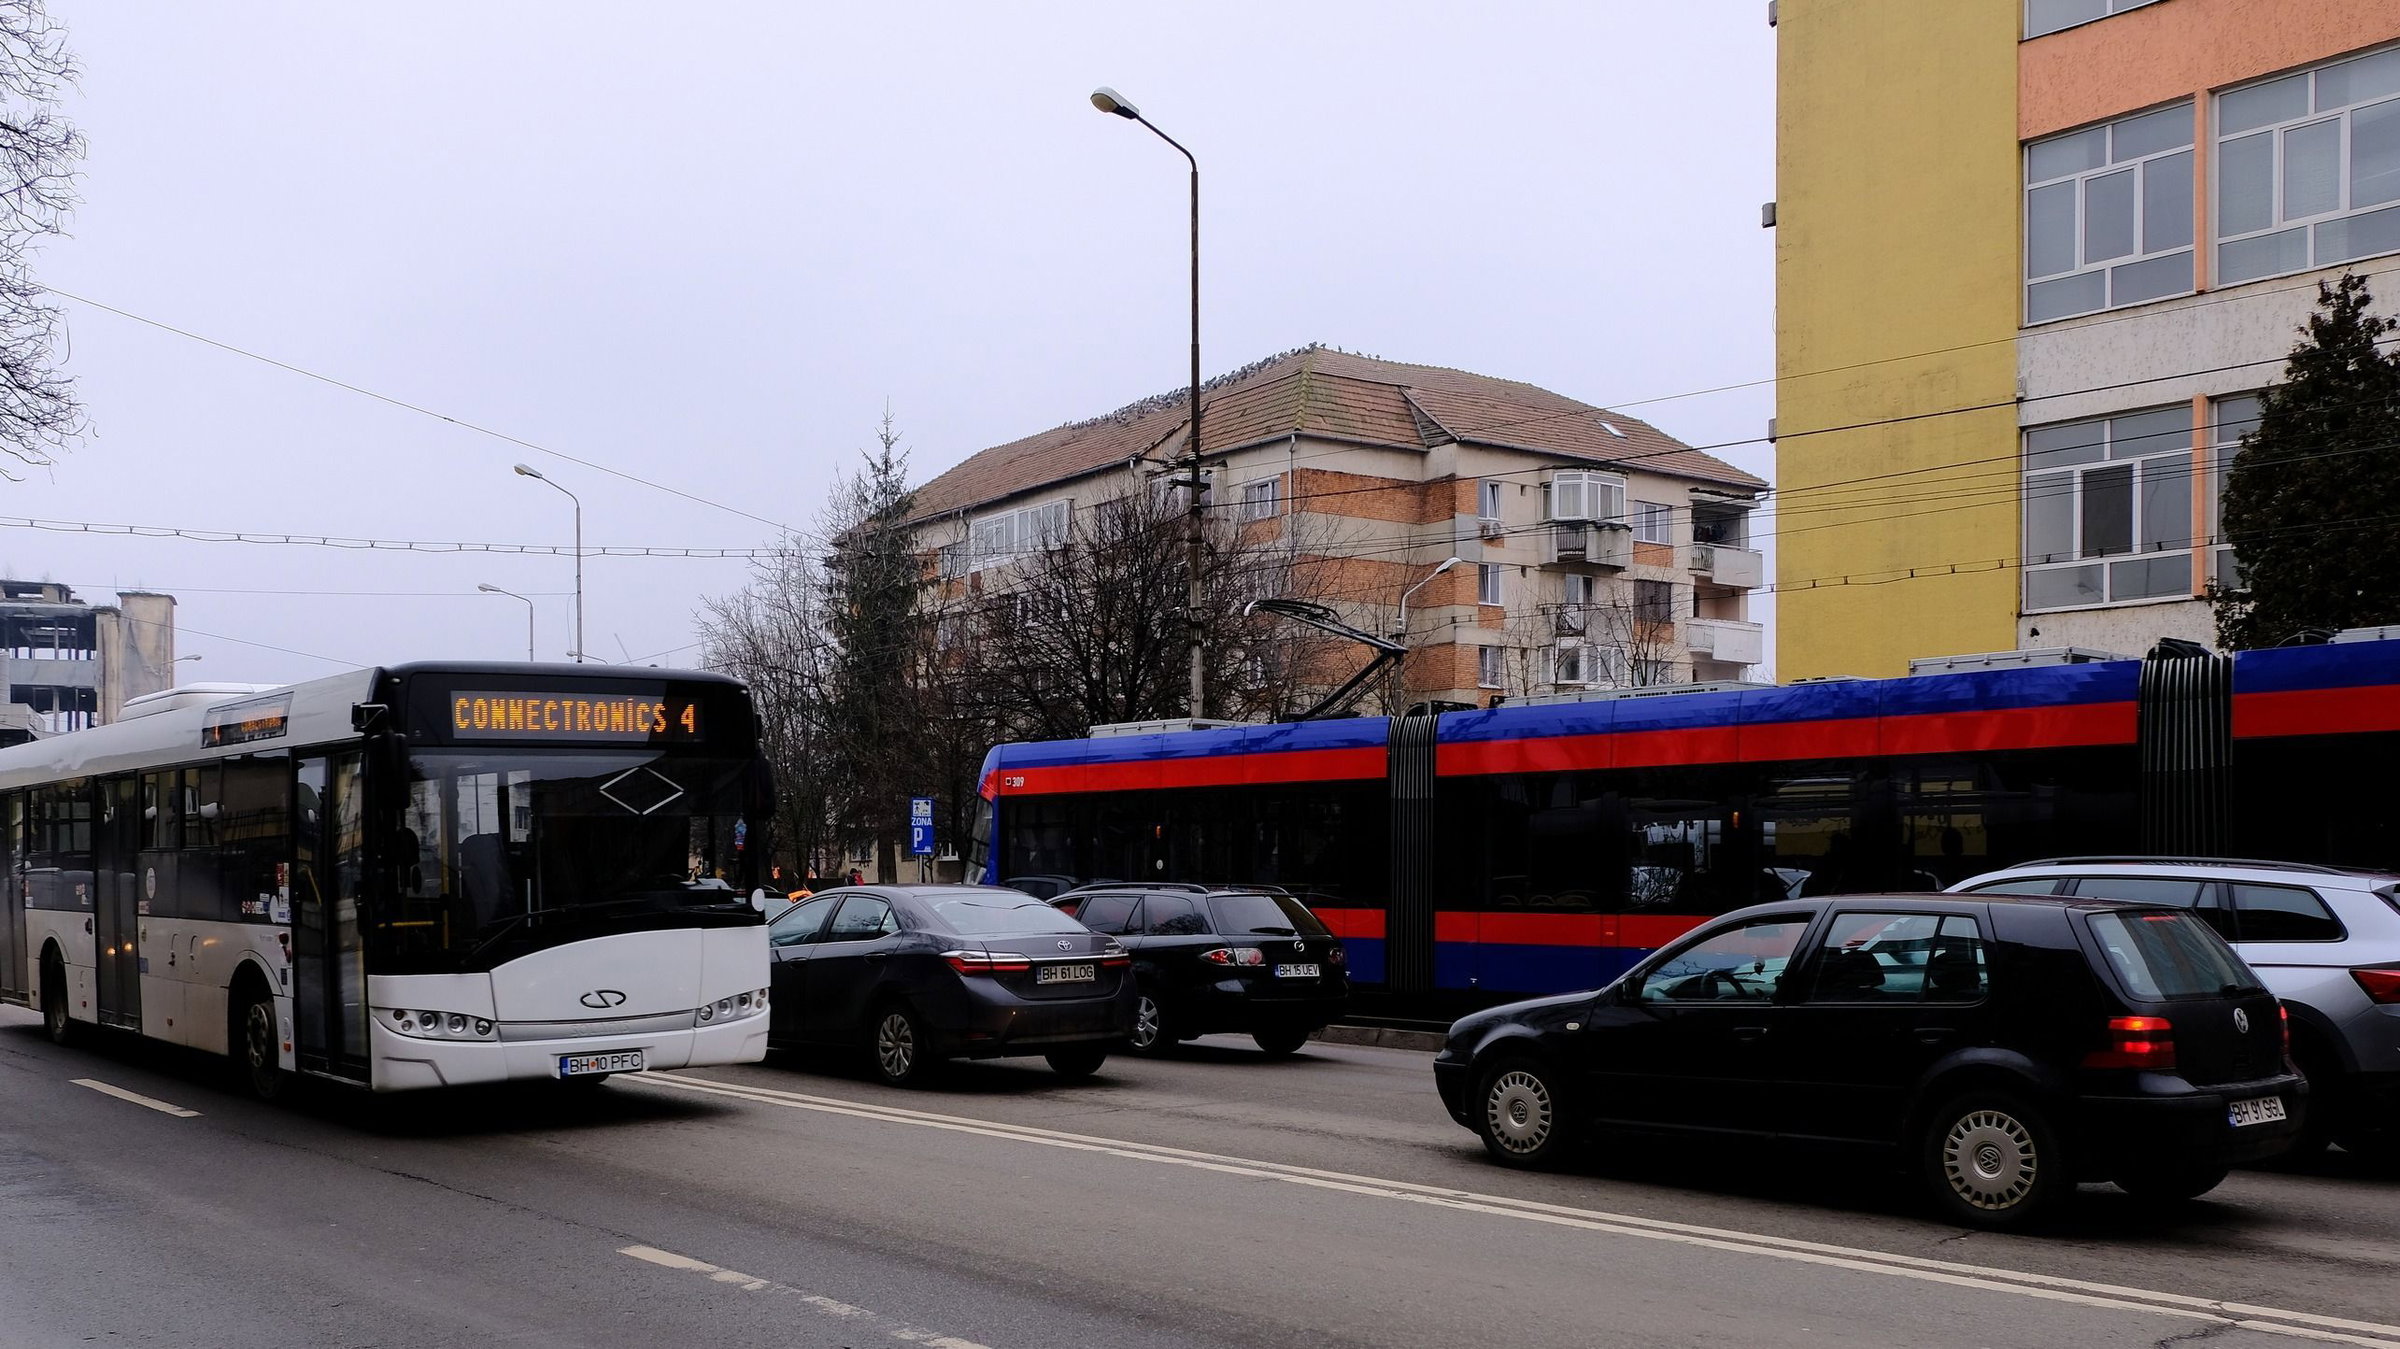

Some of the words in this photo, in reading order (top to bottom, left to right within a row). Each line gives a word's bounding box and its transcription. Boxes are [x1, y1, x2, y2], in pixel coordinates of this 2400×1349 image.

[681, 704, 695, 733] 4
[1012, 777, 1025, 787] 309
[911, 817, 932, 826] ZONA
[913, 828, 923, 848] P
[1042, 967, 1058, 980] BH
[1060, 966, 1071, 979] 61
[1074, 965, 1094, 979] LOG
[1280, 965, 1291, 976] BH
[1293, 965, 1301, 976] 15
[1303, 965, 1319, 976] UEV
[570, 1058, 590, 1073] BH
[595, 1056, 607, 1070] 10
[611, 1054, 640, 1069] PFC
[2232, 1102, 2251, 1124] BH
[2251, 1101, 2263, 1120] 91
